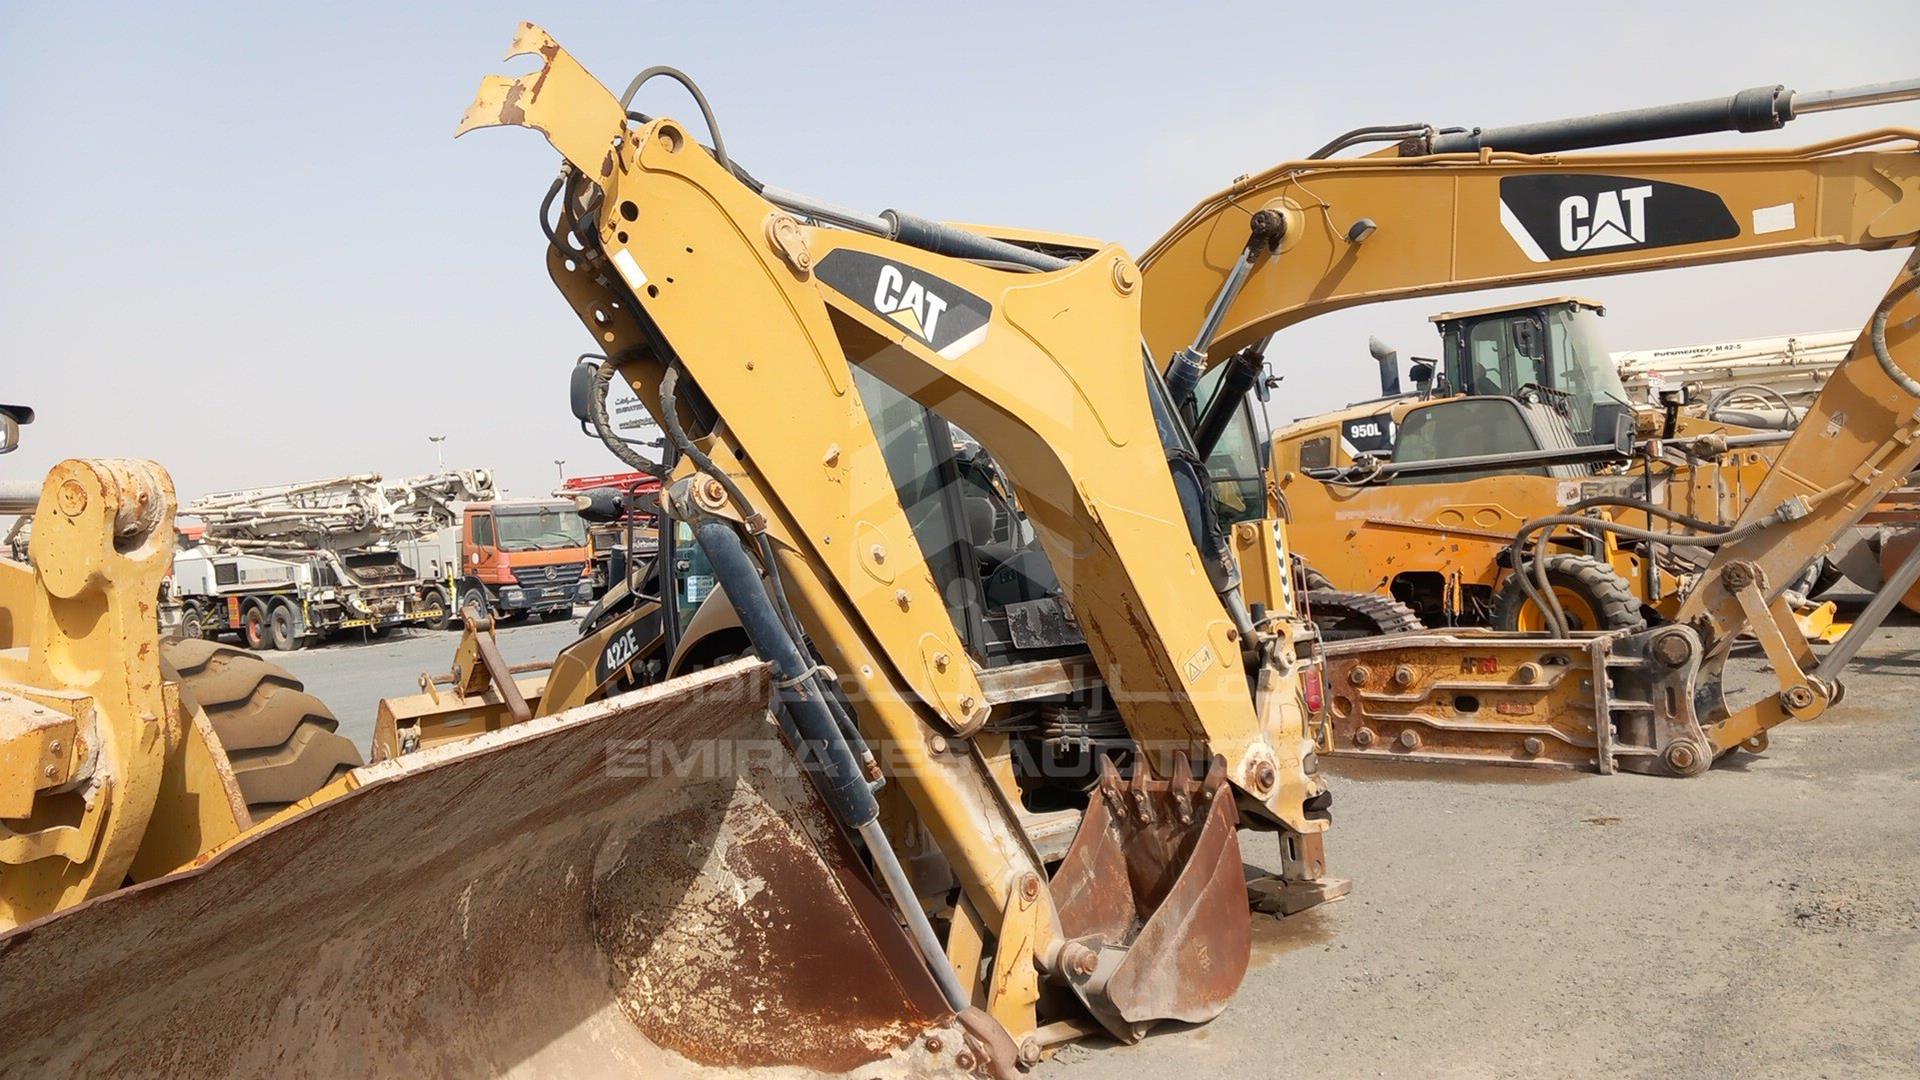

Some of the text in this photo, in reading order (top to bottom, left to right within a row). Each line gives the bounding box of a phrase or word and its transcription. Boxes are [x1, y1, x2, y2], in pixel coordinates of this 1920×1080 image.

[1560, 185, 1653, 252] CAT
[874, 264, 948, 343] CAT
[1350, 423, 1382, 439] 950L
[606, 628, 639, 670] 422E
